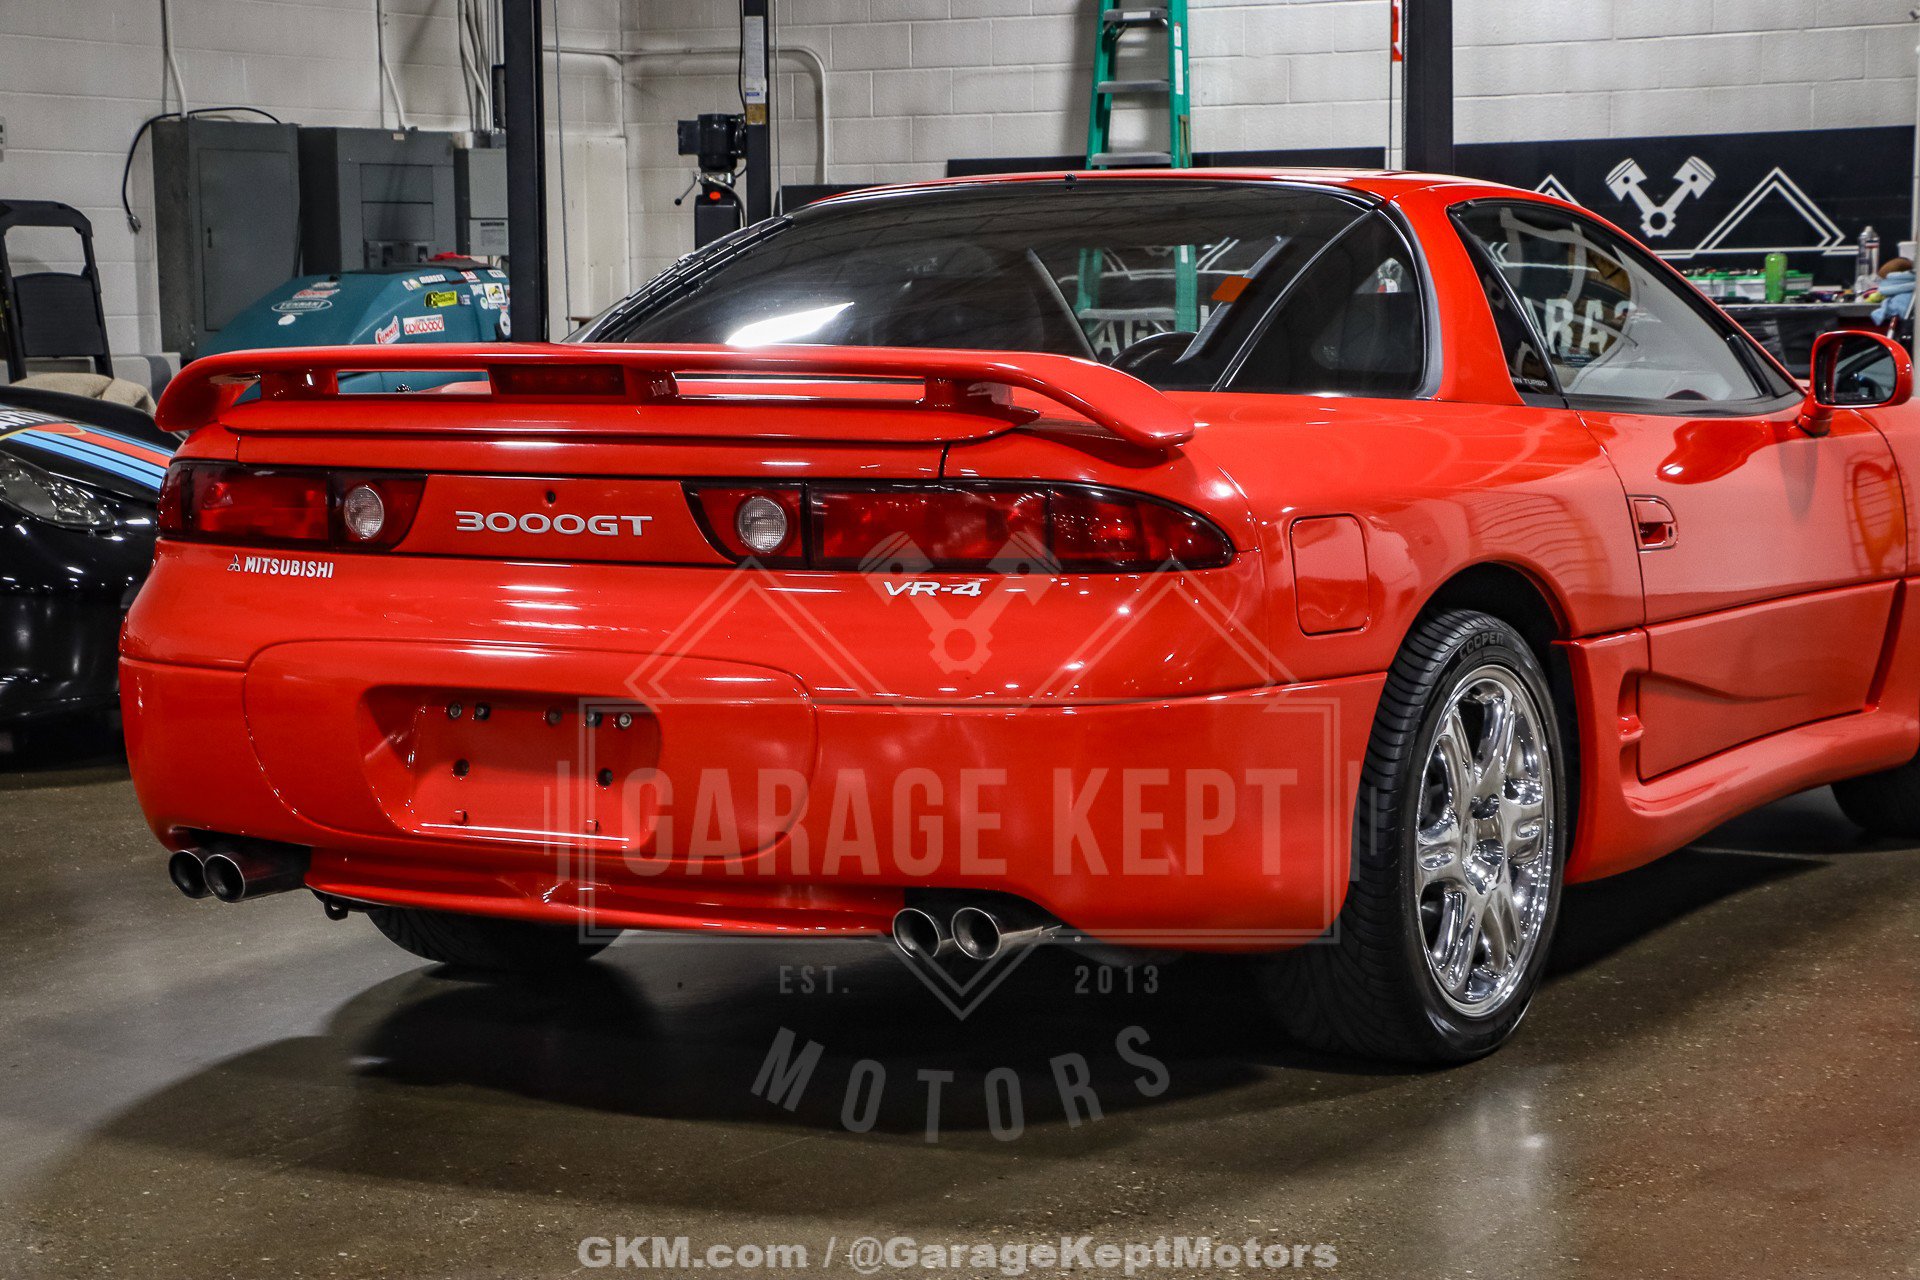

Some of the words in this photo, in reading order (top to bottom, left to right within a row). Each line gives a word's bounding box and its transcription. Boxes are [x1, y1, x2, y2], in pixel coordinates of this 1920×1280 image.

[455, 510, 653, 537] 3000GT
[243, 556, 335, 579] MITSUBISHI
[883, 581, 982, 597] VR-4
[1459, 631, 1505, 661] COOPER
